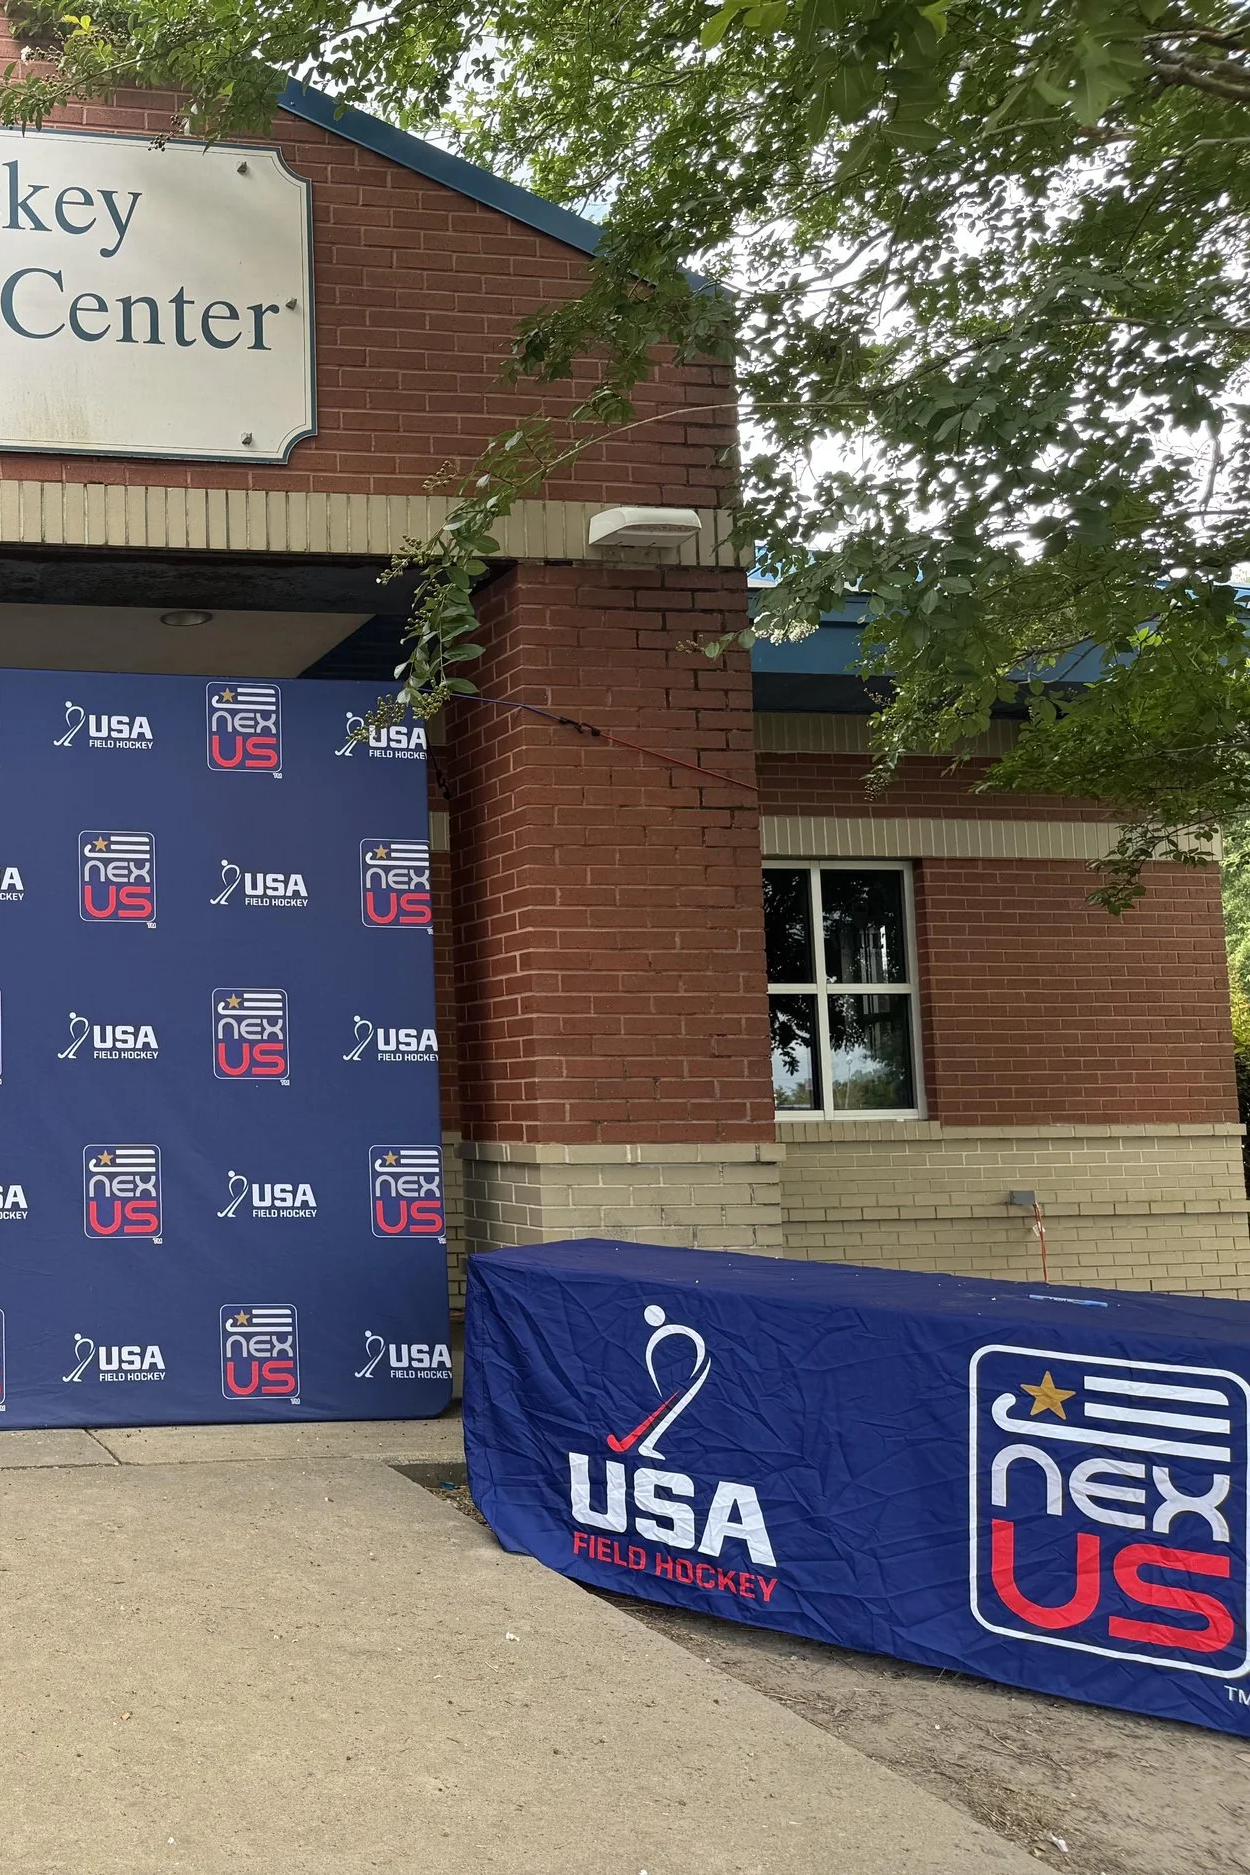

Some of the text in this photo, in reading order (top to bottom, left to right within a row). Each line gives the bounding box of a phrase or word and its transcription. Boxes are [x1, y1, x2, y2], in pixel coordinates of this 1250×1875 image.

[0, 267, 281, 351] Center
[88, 714, 154, 740] USA
[368, 724, 428, 750] USA
[89, 739, 154, 750] FIELD HOCKEY
[211, 735, 278, 768] US
[369, 749, 428, 761] FIELD HOCKE
[244, 872, 309, 897] USA
[84, 884, 153, 919] US
[245, 897, 309, 907] FIELD HOCKEY
[366, 891, 432, 924] US
[93, 1025, 159, 1049] USA
[377, 1028, 439, 1052] USA
[93, 1050, 159, 1060] FIELD HOCKEY
[217, 1042, 286, 1076] US
[377, 1052, 403, 1062] FIELD
[251, 1183, 317, 1208] USA
[89, 1200, 159, 1235] US
[252, 1209, 318, 1218] FIELD HOCKEY
[375, 1200, 443, 1234] US
[98, 1345, 166, 1371] USA
[388, 1343, 452, 1368] USA
[99, 1371, 166, 1382] FIELD HOCKEY
[226, 1360, 296, 1396] US
[390, 1369, 416, 1379] FIELD
[568, 1451, 777, 1568] USA
[573, 1532, 778, 1602] FIELD HOCKEY
[991, 1518, 1235, 1653] US
